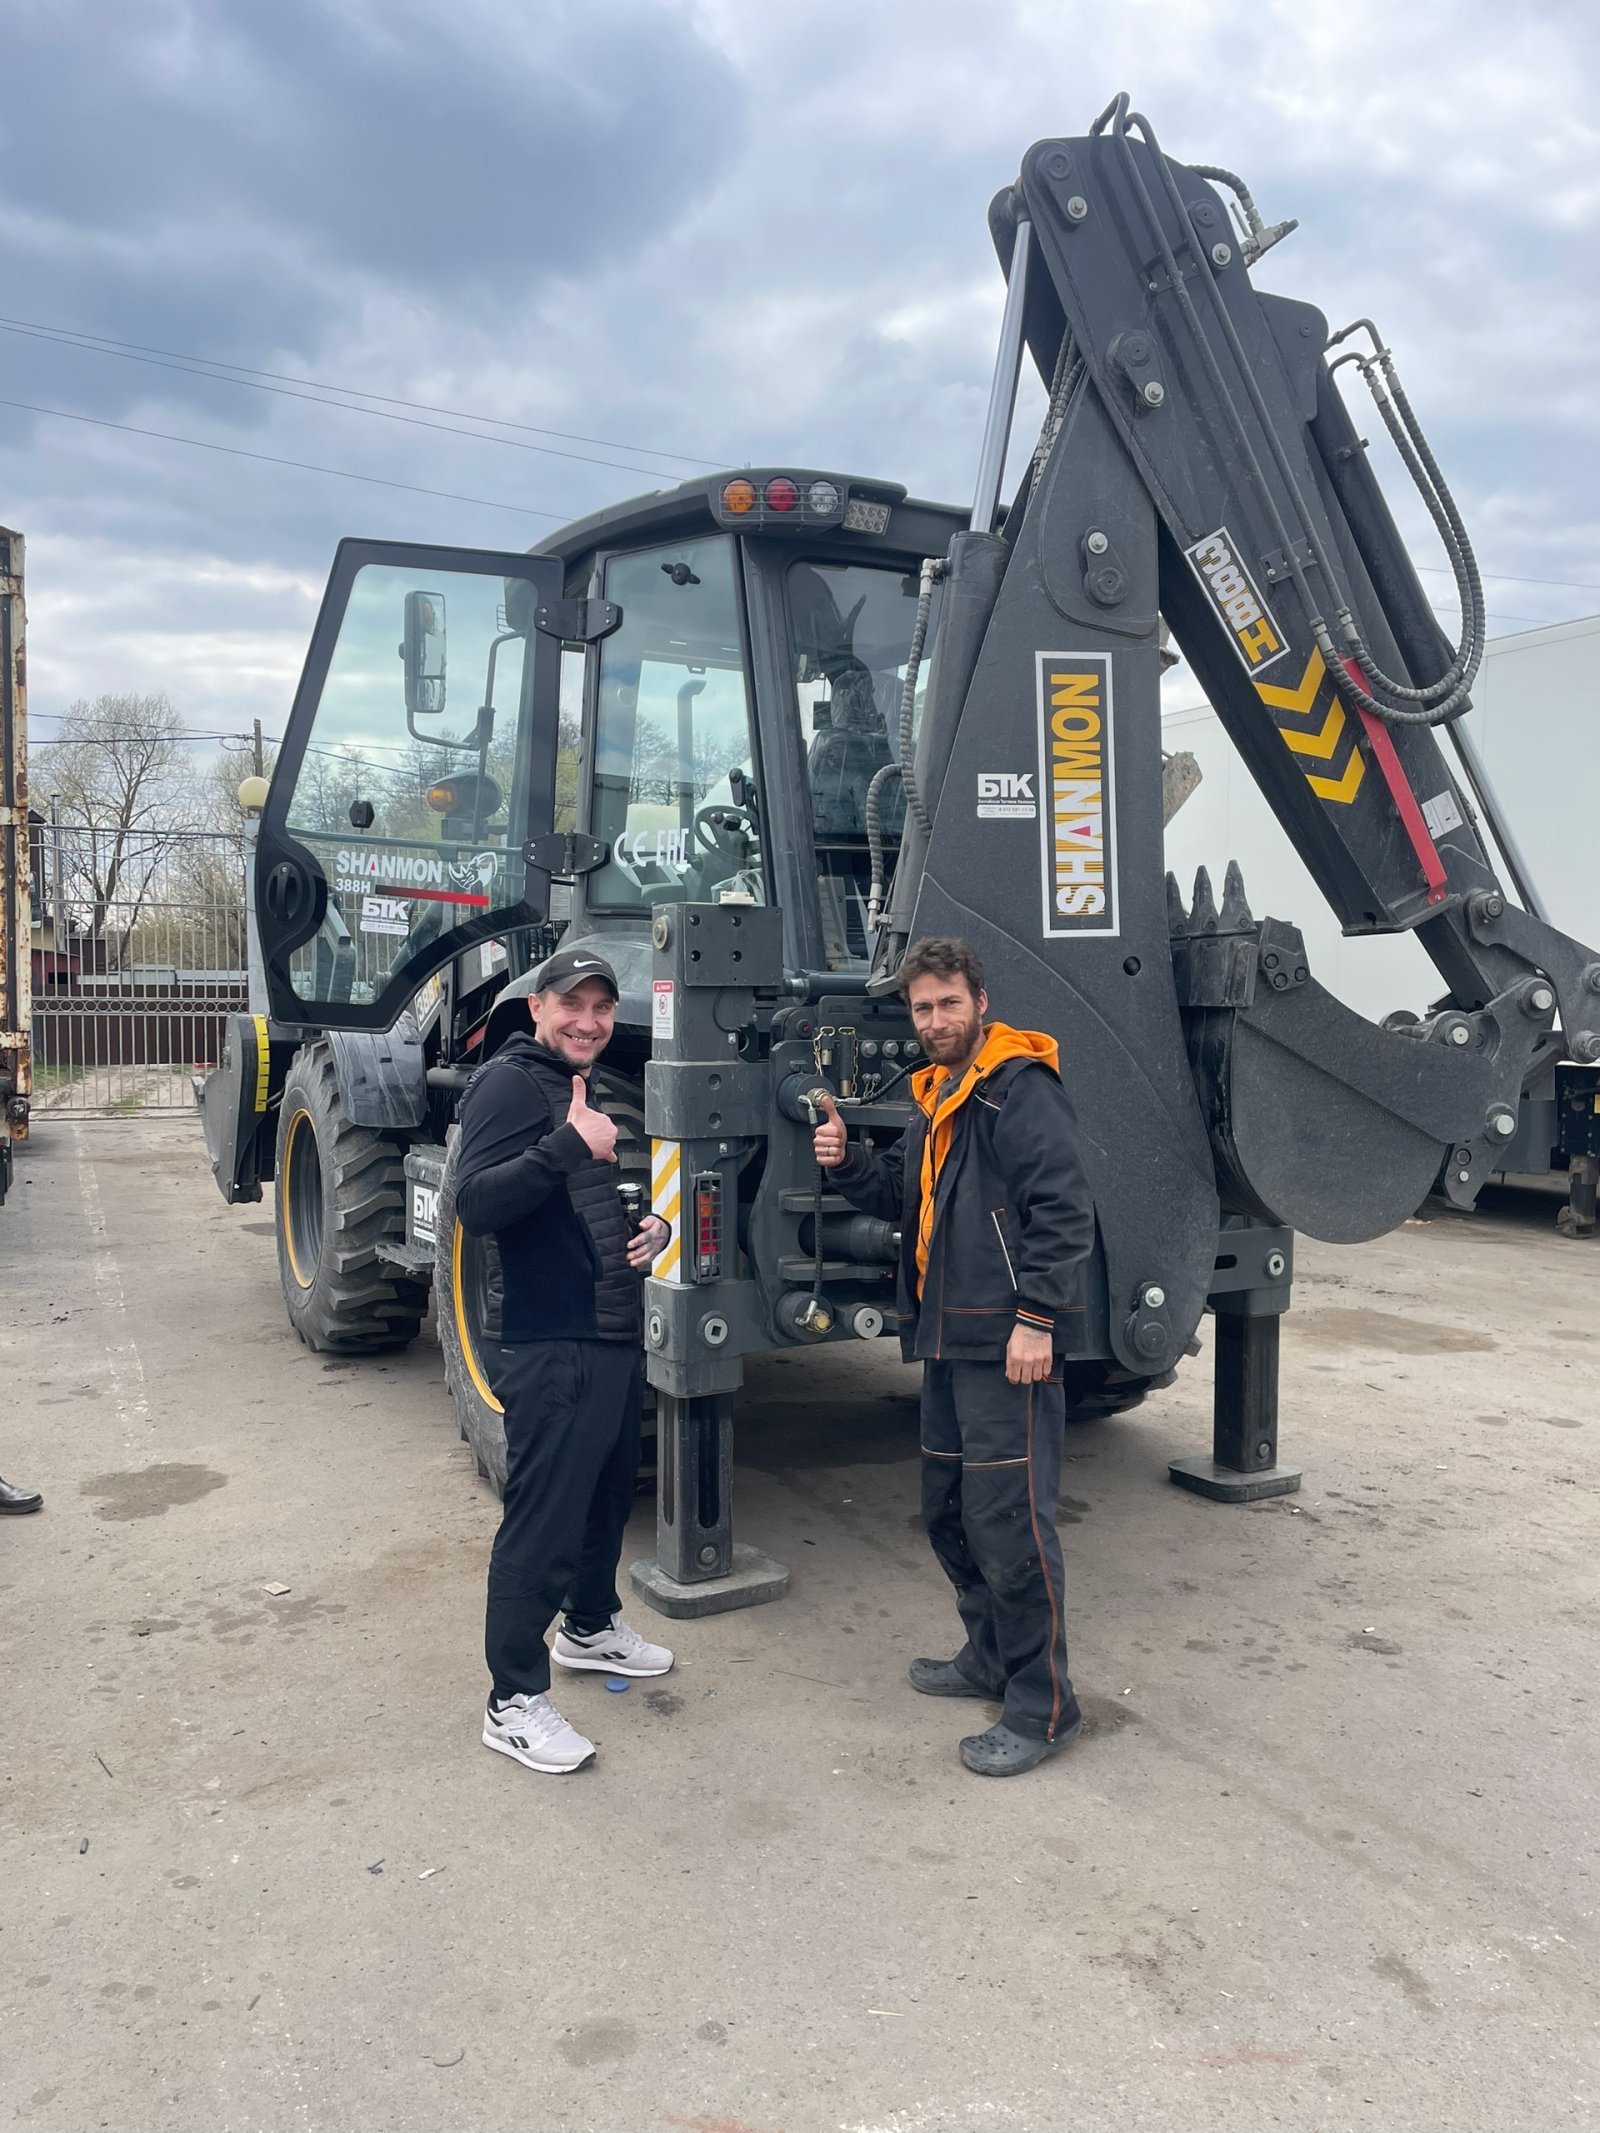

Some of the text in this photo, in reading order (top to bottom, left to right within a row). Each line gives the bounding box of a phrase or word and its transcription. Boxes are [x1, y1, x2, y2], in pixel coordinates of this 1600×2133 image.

[1195, 537, 1280, 664] 388H
[977, 773, 1035, 798] БТК
[1050, 673, 1106, 916] SHANMON
[336, 850, 443, 884] SHANMON
[335, 878, 371, 894] 388H
[362, 897, 410, 921] БТК
[413, 1184, 440, 1223] БТК
